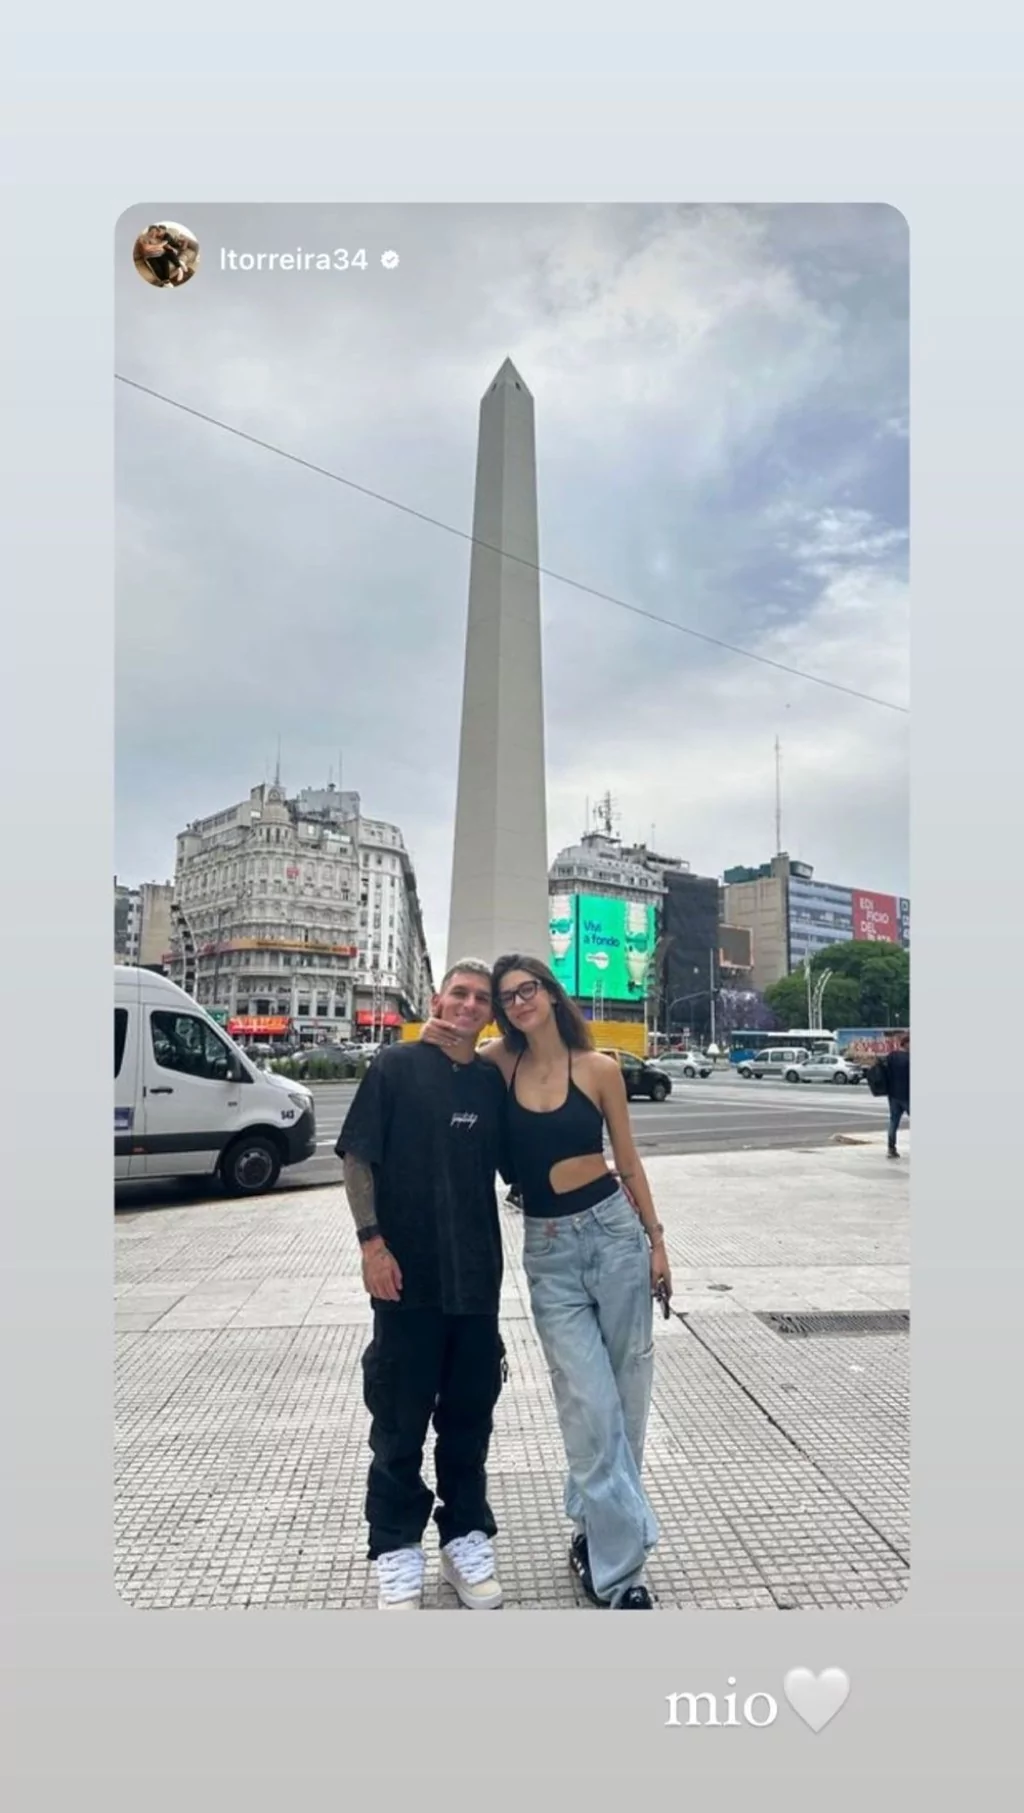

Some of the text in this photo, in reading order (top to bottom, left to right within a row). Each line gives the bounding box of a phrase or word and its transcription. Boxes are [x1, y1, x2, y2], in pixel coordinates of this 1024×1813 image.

[859, 897, 874, 911] EDI
[866, 910, 889, 925] FICIO
[860, 920, 876, 935] DEL
[583, 933, 620, 948] a fondo
